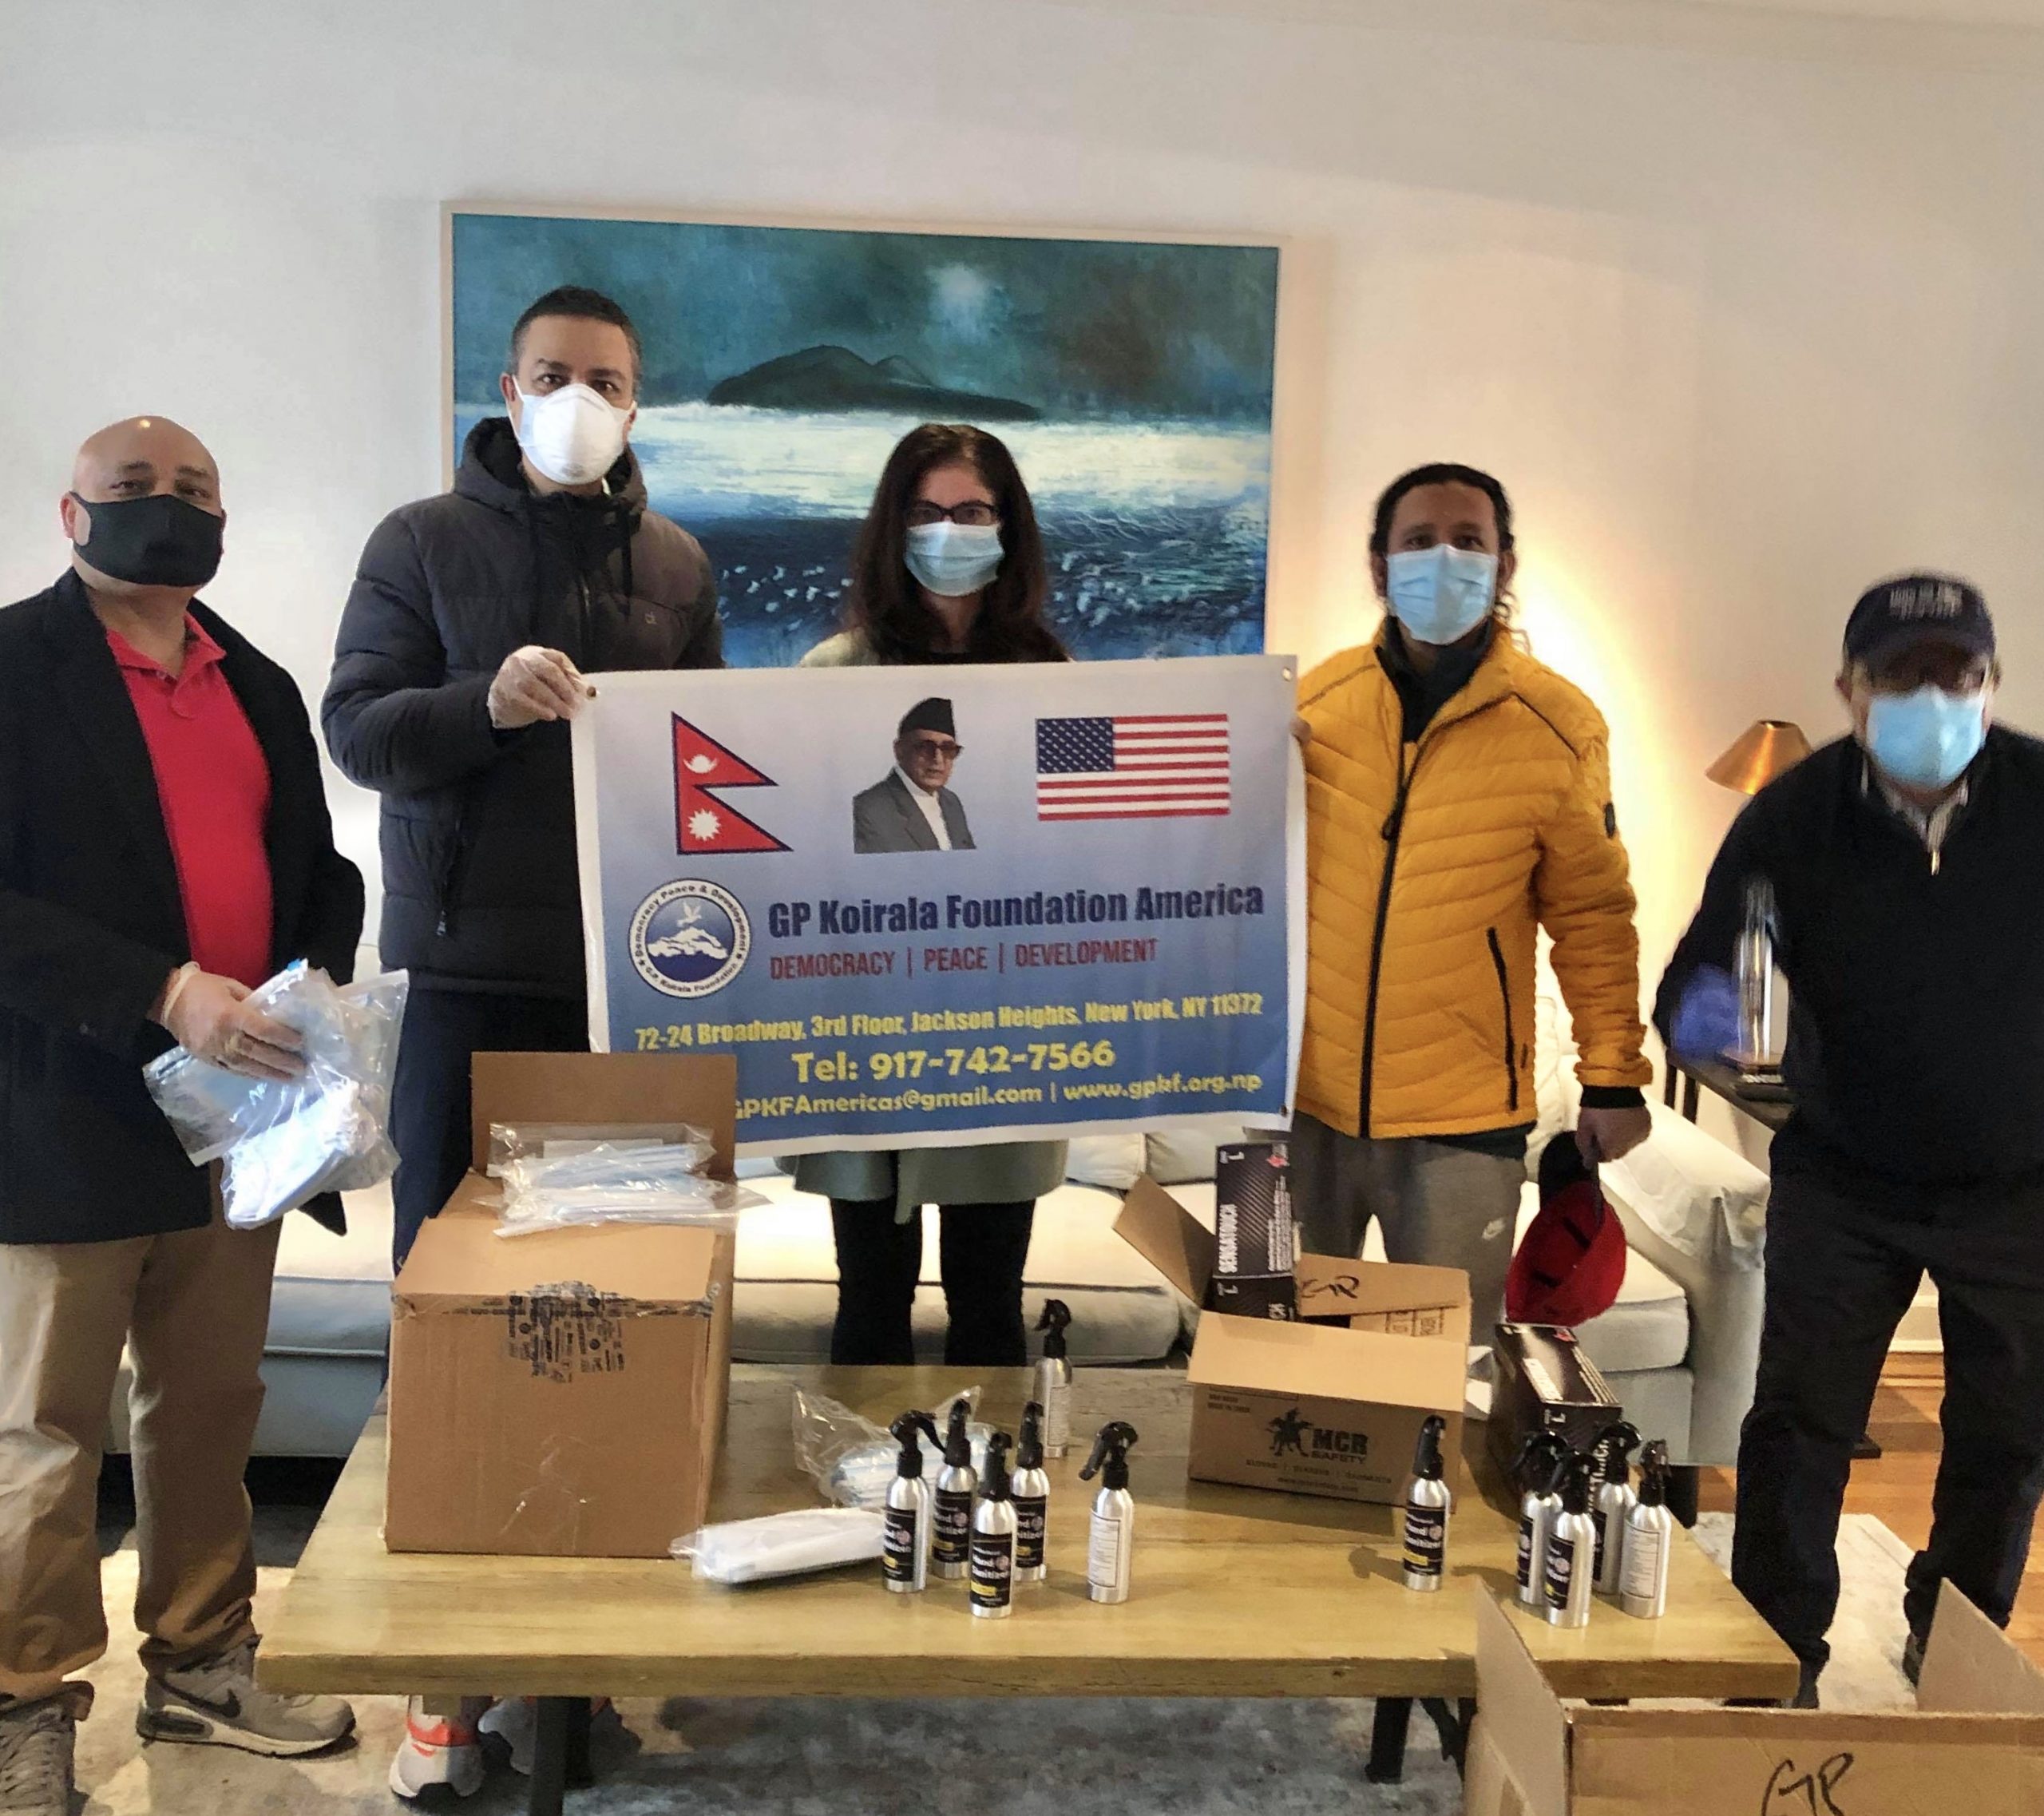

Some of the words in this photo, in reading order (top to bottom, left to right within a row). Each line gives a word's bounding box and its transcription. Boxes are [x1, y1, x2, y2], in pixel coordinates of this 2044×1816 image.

[768, 901, 811, 938] GP
[818, 896, 938, 934] Koirala
[946, 890, 1127, 929] Foundation
[1135, 883, 1264, 921] America
[770, 951, 895, 980] DEMOCRACY
[924, 946, 988, 972] PEACE
[1015, 938, 1159, 967] DEVELOPMENT
[634, 1024, 693, 1051] 72-24
[810, 1014, 847, 1037] 3rd
[911, 1009, 995, 1033] Jackson
[1085, 1001, 1128, 1023] New
[1182, 996, 1207, 1018] NY
[1211, 992, 1263, 1017] 11372
[790, 1051, 859, 1083] Tel:
[869, 1039, 1116, 1080] 917-742-7566
[1063, 1071, 1263, 1100] www.gpkf.org.np
[1218, 1204, 1238, 1273] SENSATOUCH
[1311, 1449, 1367, 1465] SAFETY
[1312, 1428, 1369, 1455] MCR
